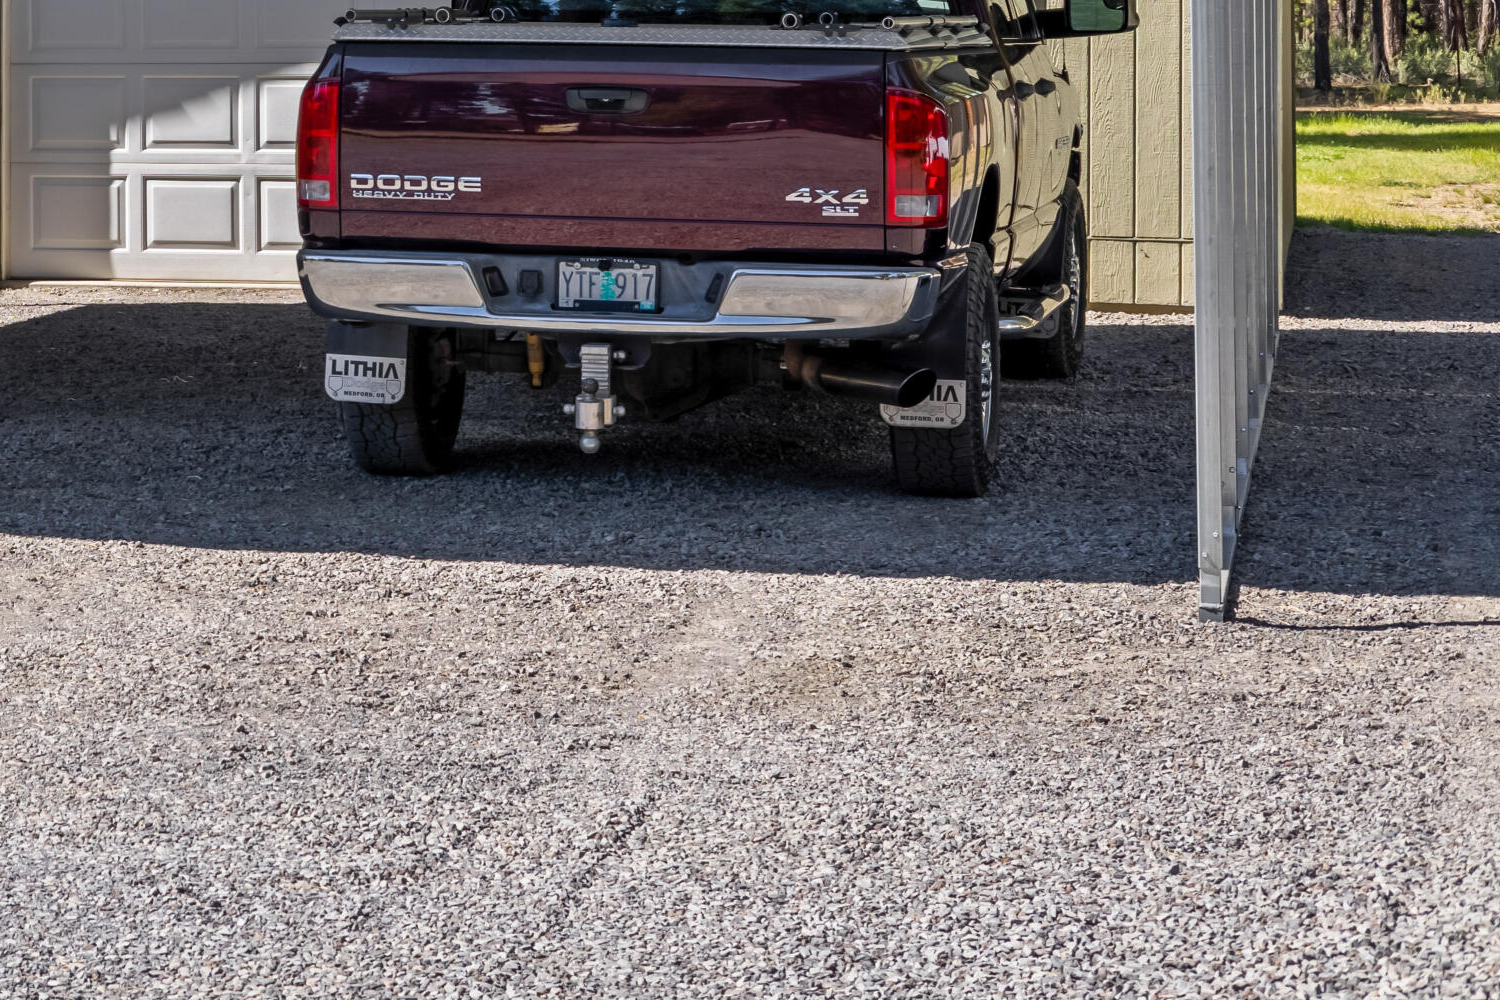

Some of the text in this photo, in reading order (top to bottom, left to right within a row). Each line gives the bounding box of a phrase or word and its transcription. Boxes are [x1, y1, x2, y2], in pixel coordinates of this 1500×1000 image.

[350, 173, 482, 192] DODGE
[352, 190, 456, 200] HEAVY DUTY
[822, 206, 859, 216] SLT
[562, 271, 654, 300] YTF 917
[331, 359, 399, 380] LITHIA
[344, 390, 375, 398] MEDFORD,
